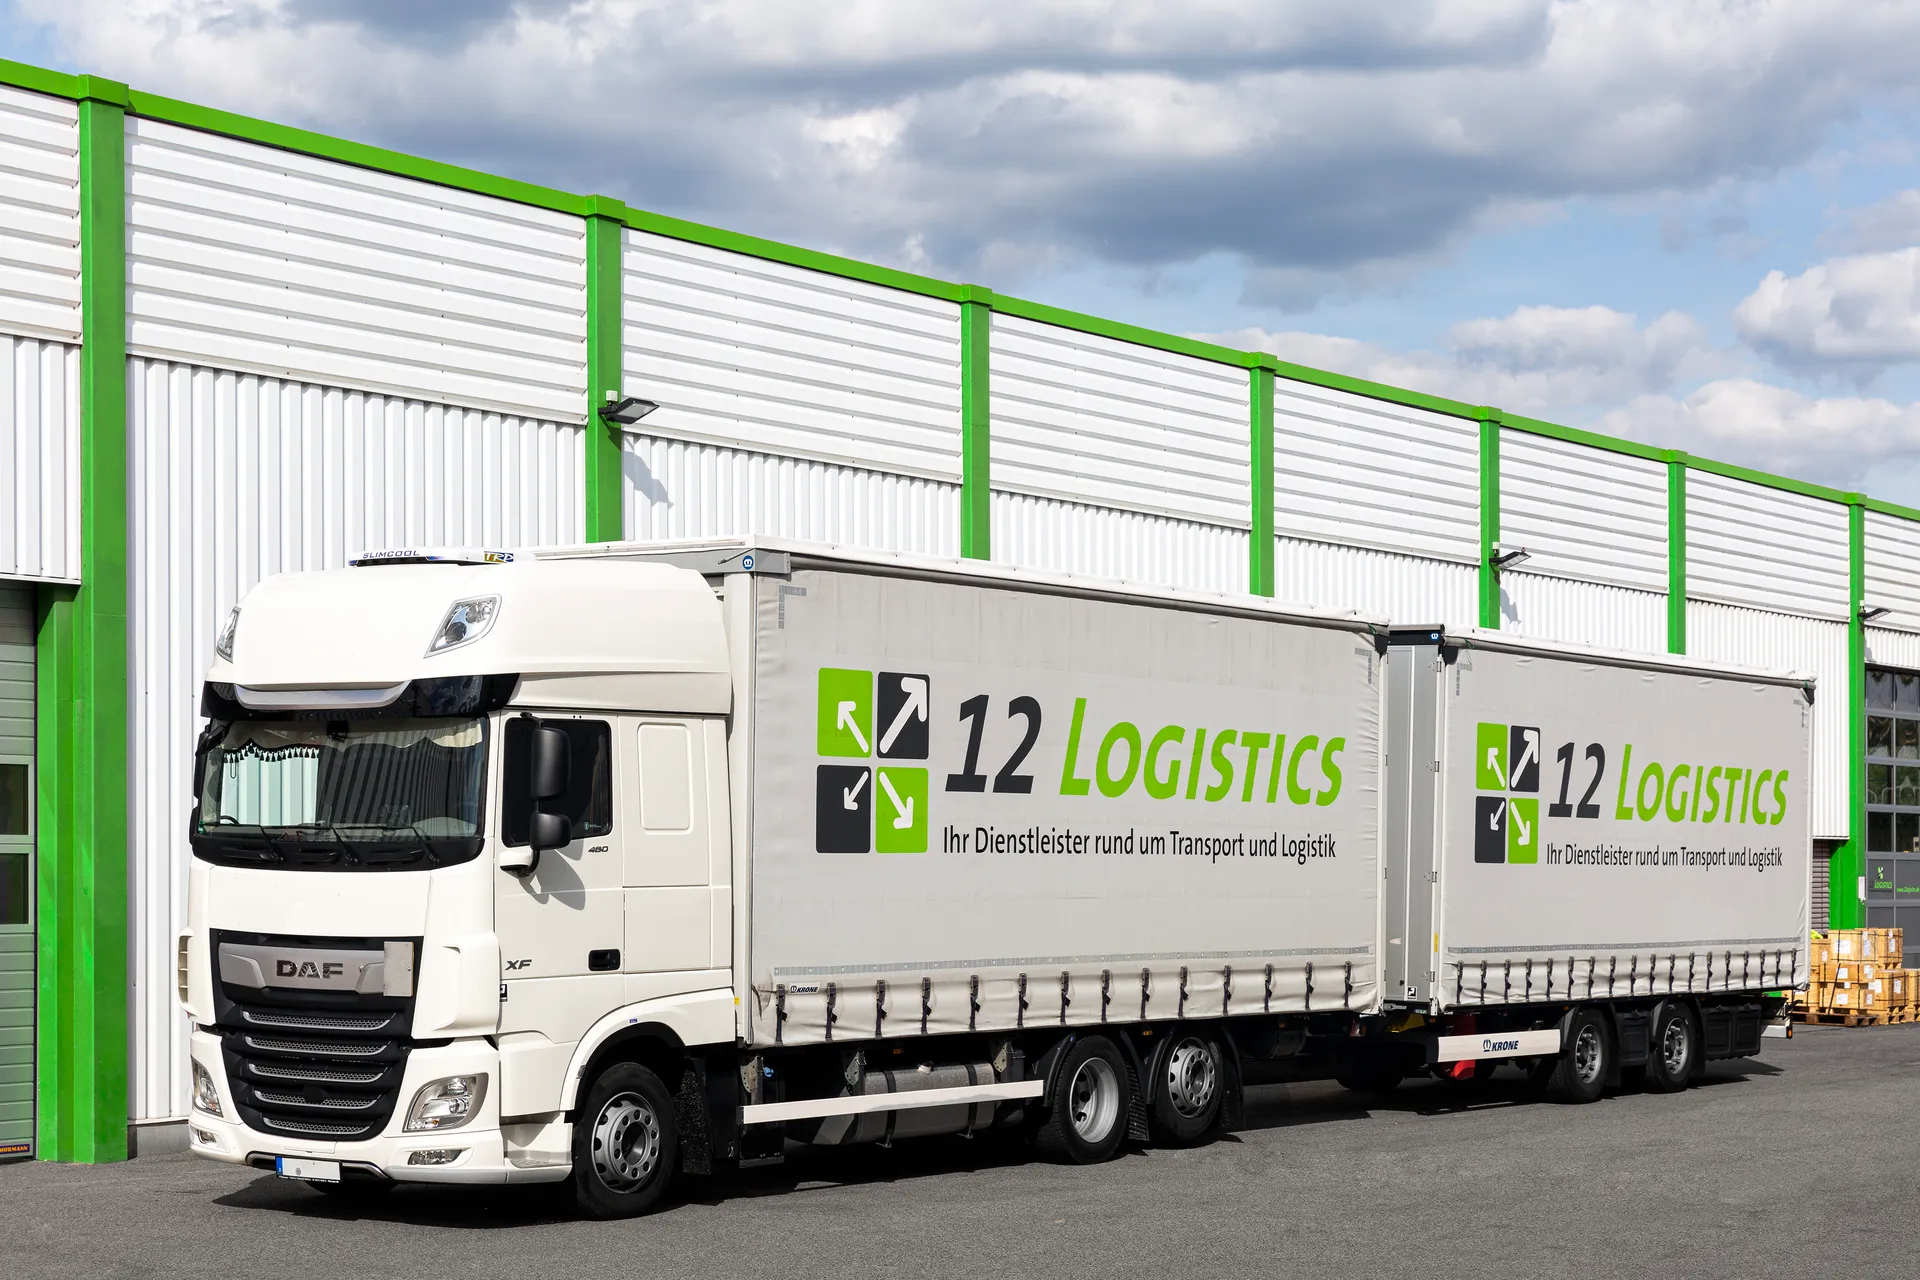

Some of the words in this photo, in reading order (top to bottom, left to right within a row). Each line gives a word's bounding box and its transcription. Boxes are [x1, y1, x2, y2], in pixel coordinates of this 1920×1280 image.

[363, 549, 420, 559] SLIMCOOL
[485, 551, 514, 563] TRP
[945, 694, 1042, 794] 12
[1059, 697, 1346, 807] LOGISTICS
[1548, 742, 1606, 819] 12
[1615, 744, 1789, 825] LOGISTICS
[943, 825, 970, 854] Ihr
[975, 826, 1090, 854] Dienstleister
[1095, 828, 1134, 855] rund
[1139, 835, 1166, 855] um
[1170, 830, 1245, 864] Transport
[1249, 832, 1277, 857] und
[1282, 833, 1336, 865] Logistik
[1546, 843, 1563, 865] Ihr
[1565, 843, 1634, 866] Dienstleister
[1635, 845, 1660, 866] rund
[1662, 851, 1679, 866] um
[1681, 846, 1726, 872] Transport
[1728, 846, 1746, 866] und
[1748, 847, 1783, 872] Logistik
[276, 960, 343, 979] DAF
[505, 959, 532, 971] XF
[1491, 1040, 1519, 1051] KRONE
